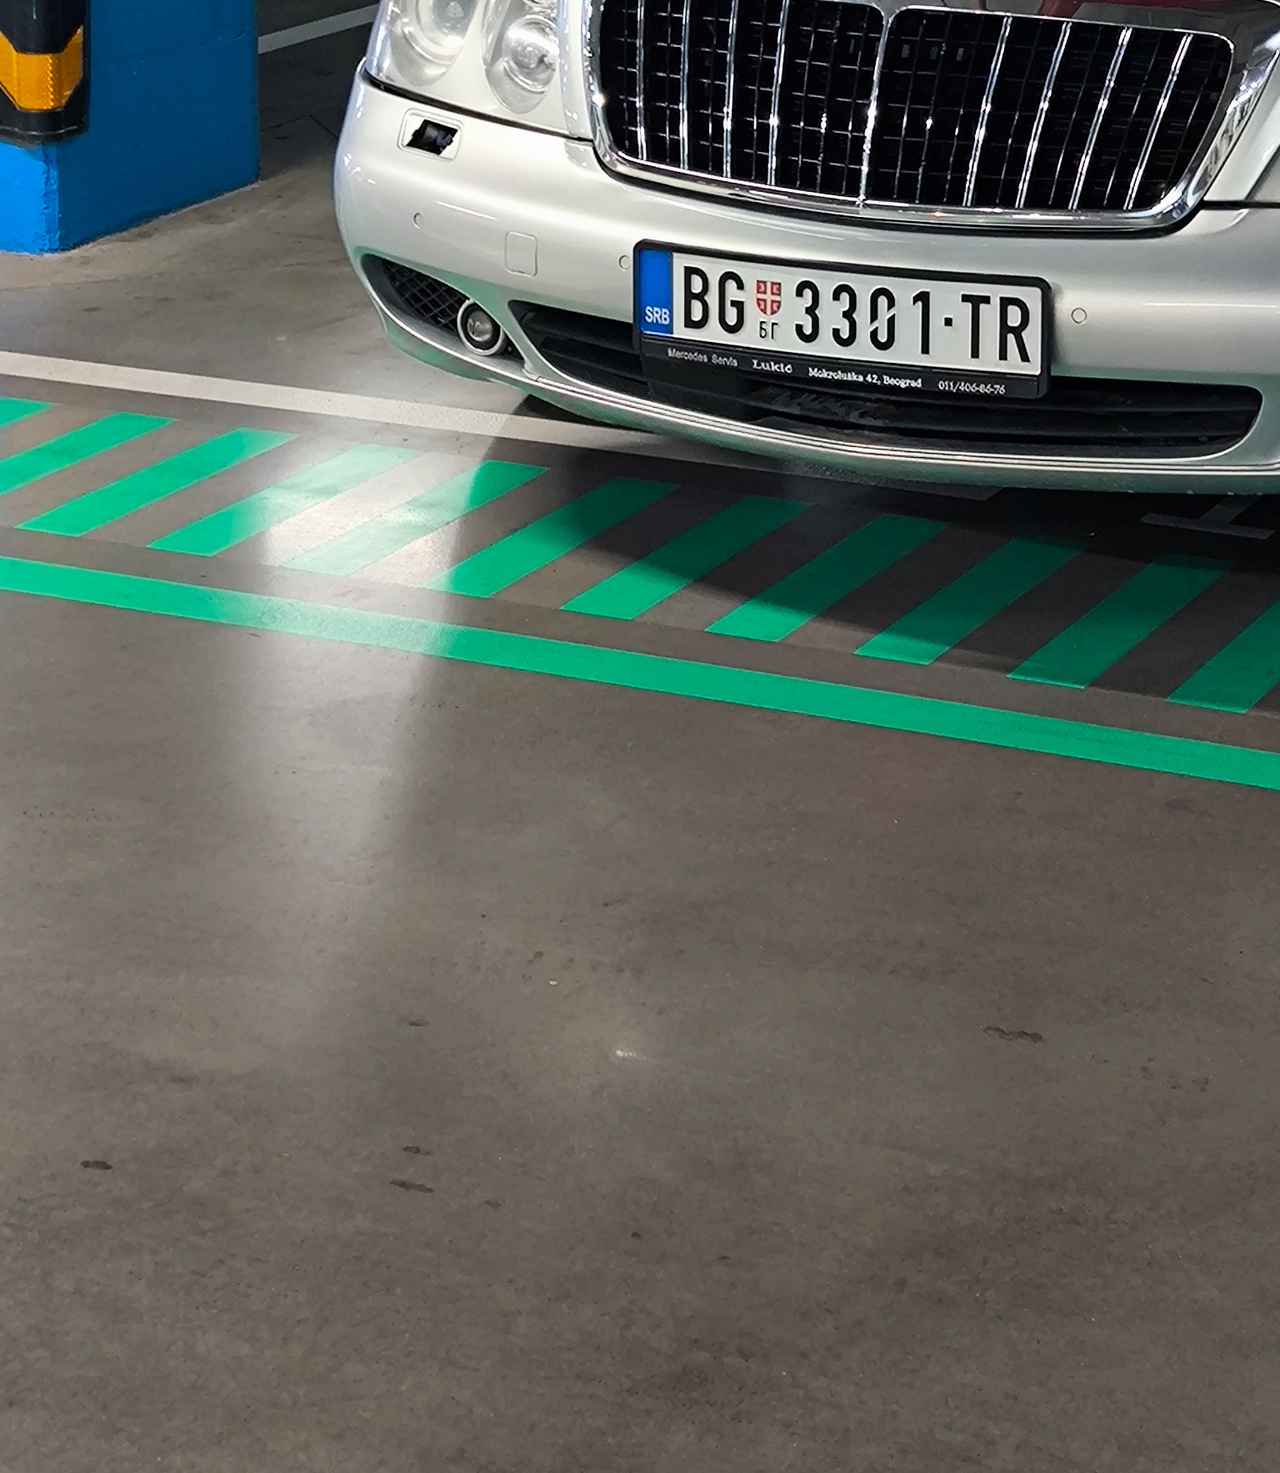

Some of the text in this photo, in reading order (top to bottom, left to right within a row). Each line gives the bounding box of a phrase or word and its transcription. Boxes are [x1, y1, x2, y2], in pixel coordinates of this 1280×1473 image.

[684, 266, 744, 334] BG
[645, 306, 670, 324] SRB
[759, 321, 778, 339] БГ
[667, 348, 708, 363] Mercedes
[711, 353, 738, 367] Servis
[883, 375, 922, 388] Beograd
